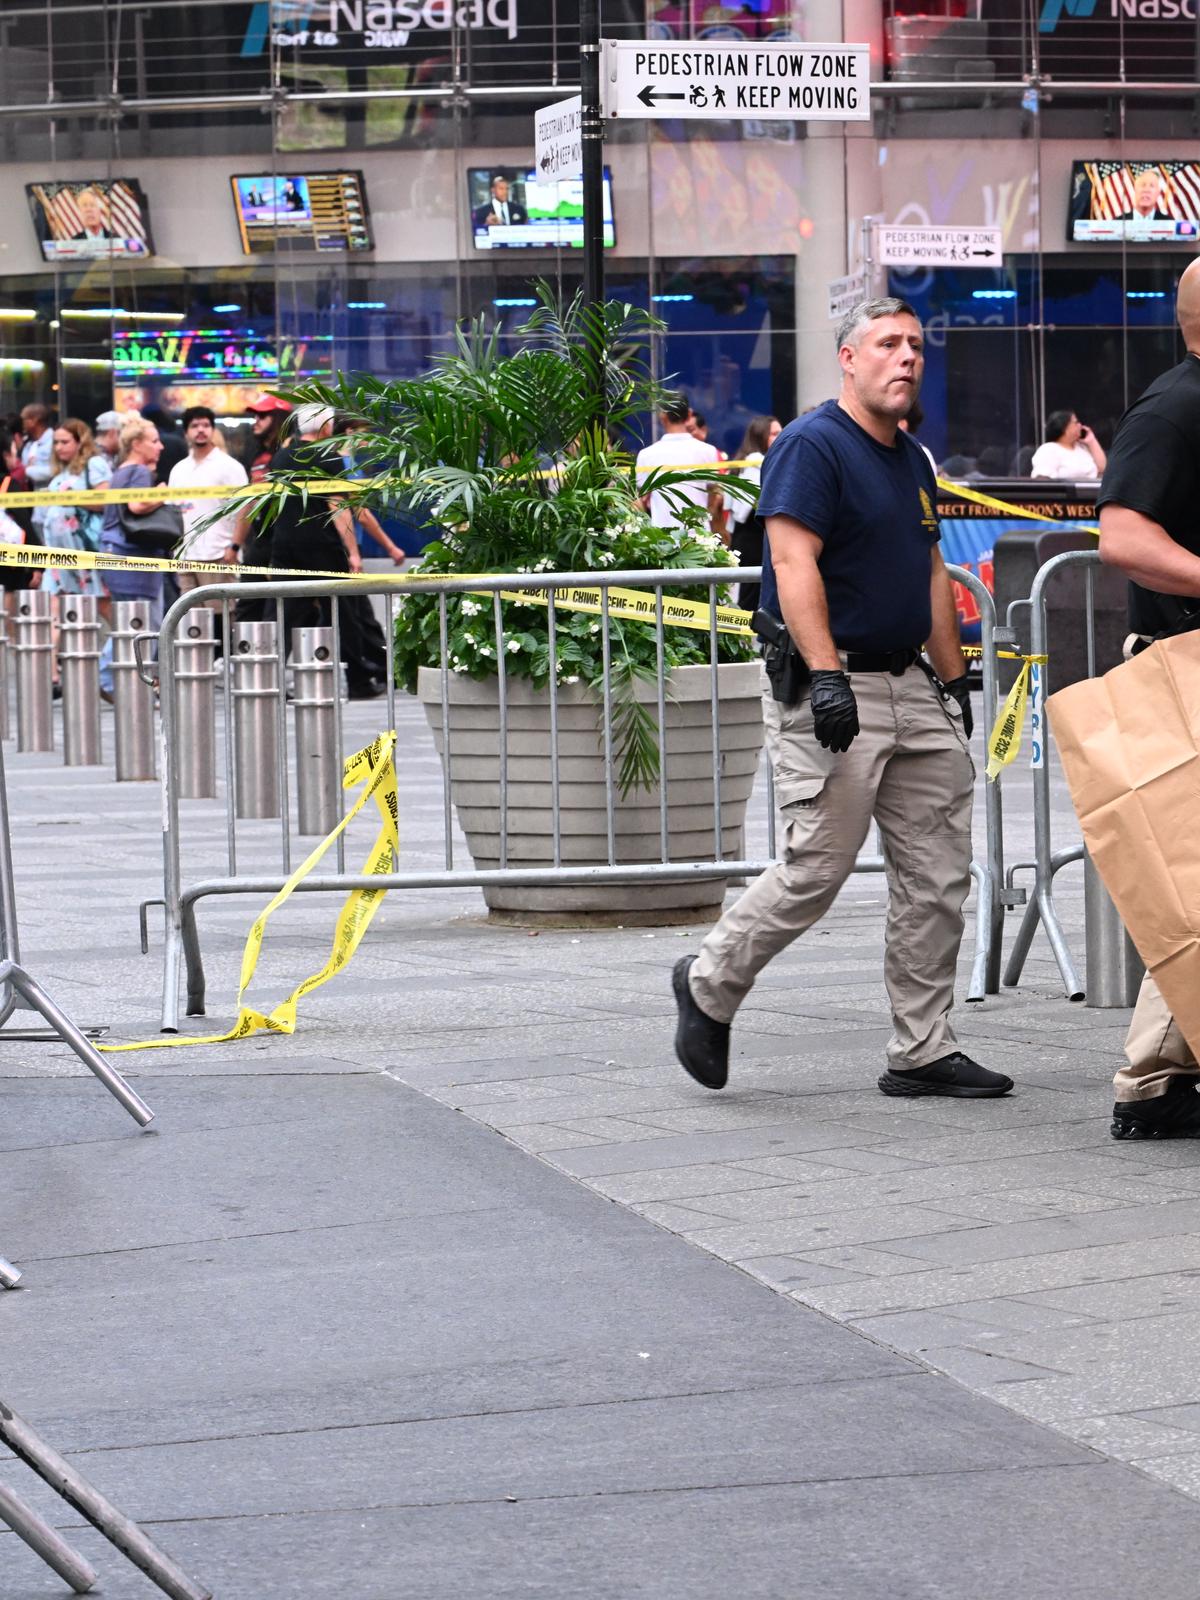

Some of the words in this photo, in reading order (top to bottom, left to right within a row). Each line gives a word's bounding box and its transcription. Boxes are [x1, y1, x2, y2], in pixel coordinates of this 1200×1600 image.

[636, 53, 748, 76] PEDESTRIAN
[755, 54, 803, 77] FLOW
[810, 55, 857, 78] ZONE
[737, 86, 781, 108] KEEP
[788, 86, 858, 109] MOVING
[885, 232, 942, 243] PEDESTRIAN
[945, 233, 969, 243] FLOW
[973, 233, 995, 244] ZONE
[886, 248, 910, 258] KEEP
[913, 248, 947, 258] MOVING
[17, 551, 29, 564] DO
[31, 553, 48, 565] NOT
[50, 554, 78, 567] CROSS
